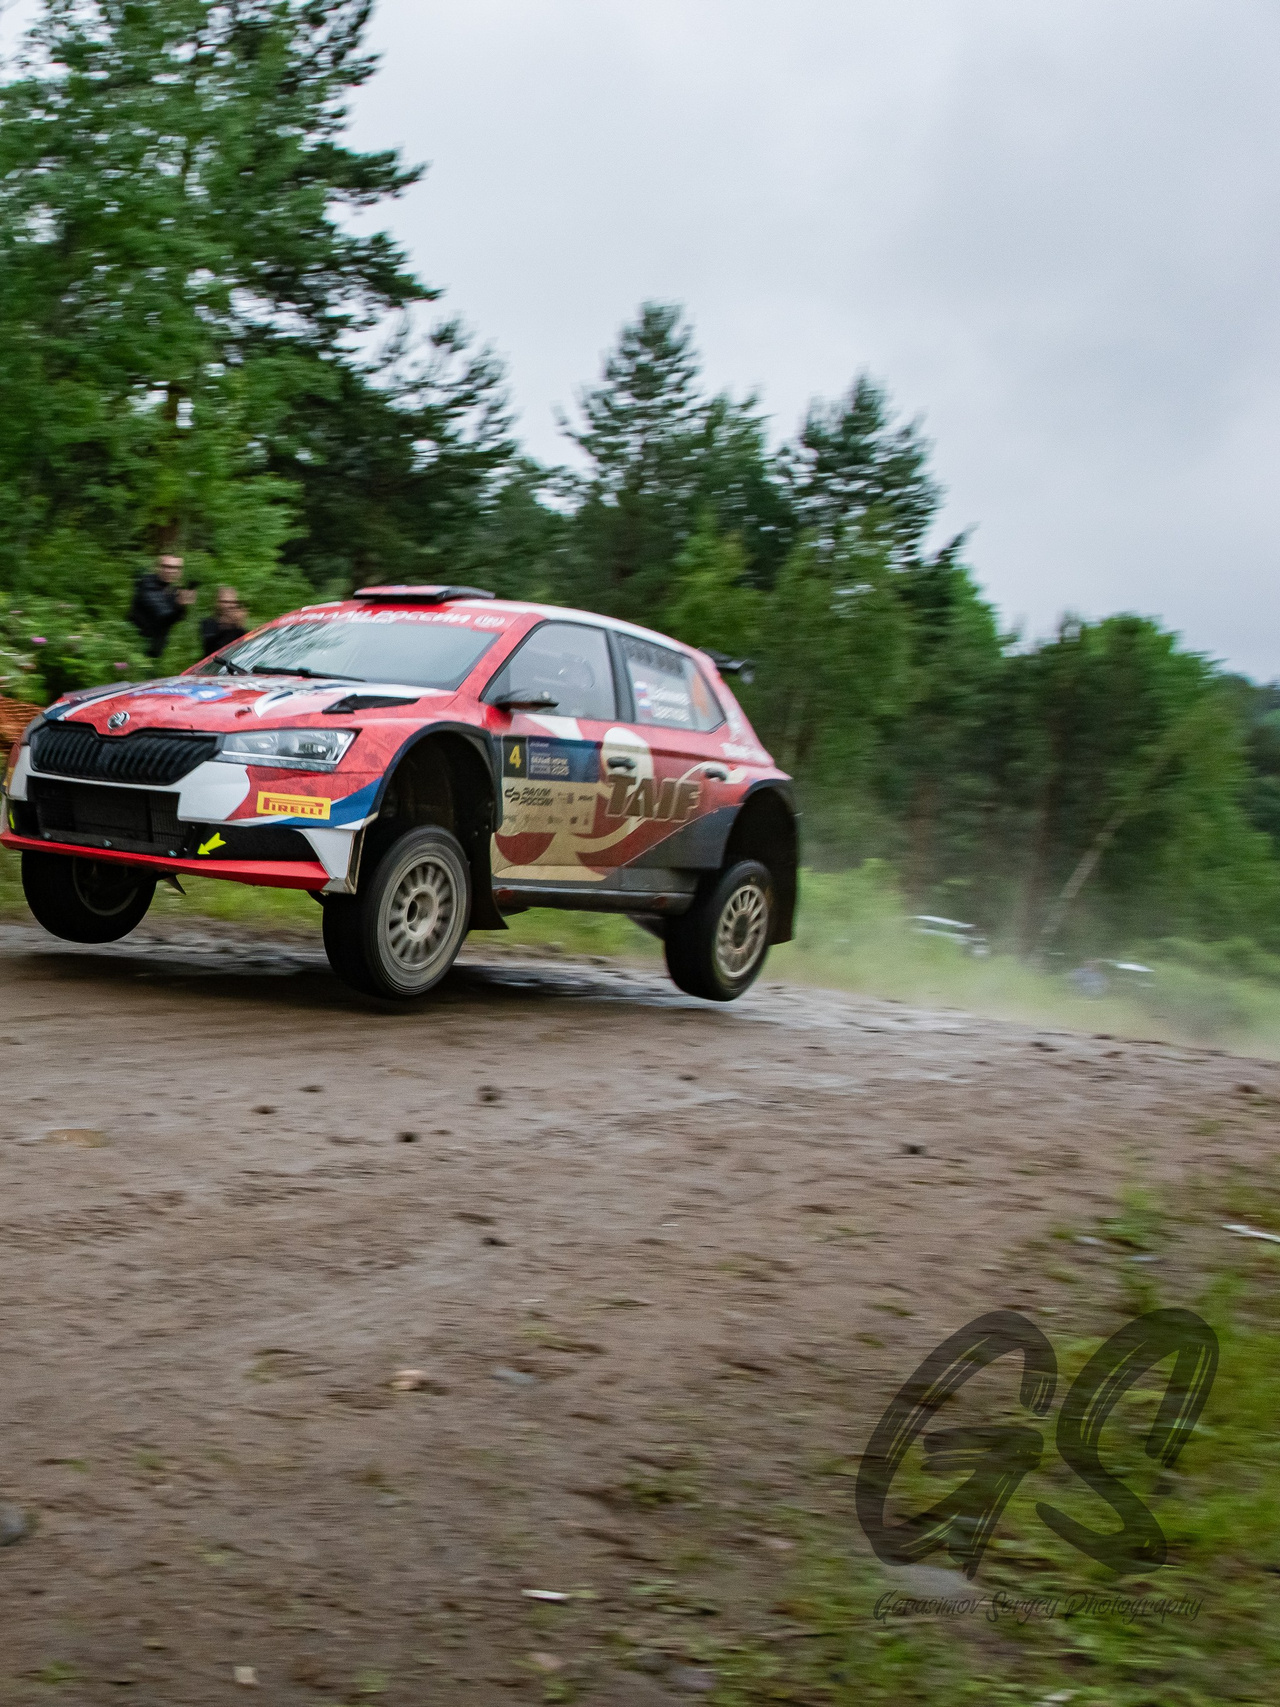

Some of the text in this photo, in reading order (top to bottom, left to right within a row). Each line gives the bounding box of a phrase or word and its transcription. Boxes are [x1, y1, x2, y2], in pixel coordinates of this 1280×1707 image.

[509, 745, 522, 769] 4
[522, 787, 551, 797] РАЛЛИ
[606, 774, 701, 822] TAIF
[263, 797, 324, 815] PIRELLI
[519, 796, 554, 807] РОССИИ
